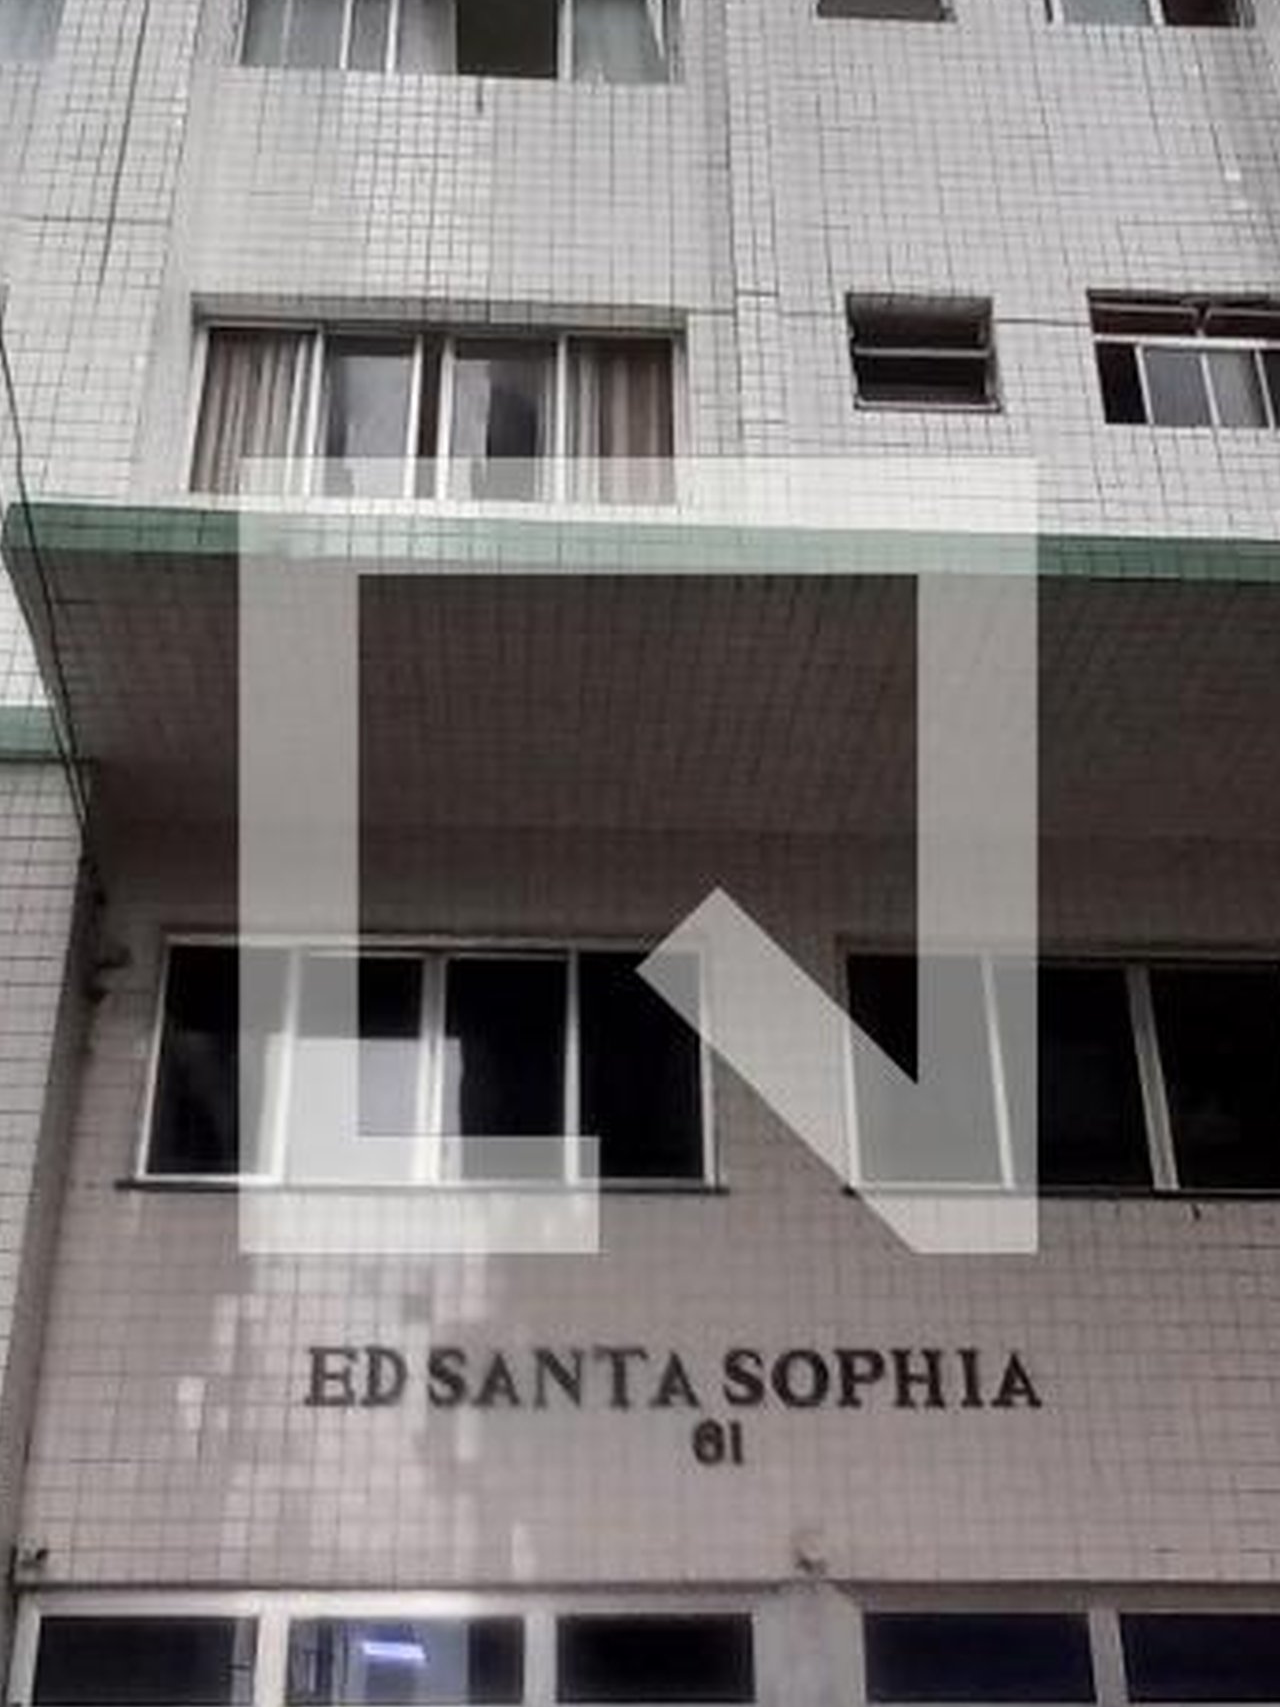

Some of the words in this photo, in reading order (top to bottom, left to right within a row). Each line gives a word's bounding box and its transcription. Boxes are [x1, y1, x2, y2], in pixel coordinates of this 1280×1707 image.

[304, 1346, 408, 1408] ED
[428, 1346, 701, 1409] SANTA
[723, 1348, 1043, 1409] SOPHIA
[692, 1417, 744, 1466] 61
